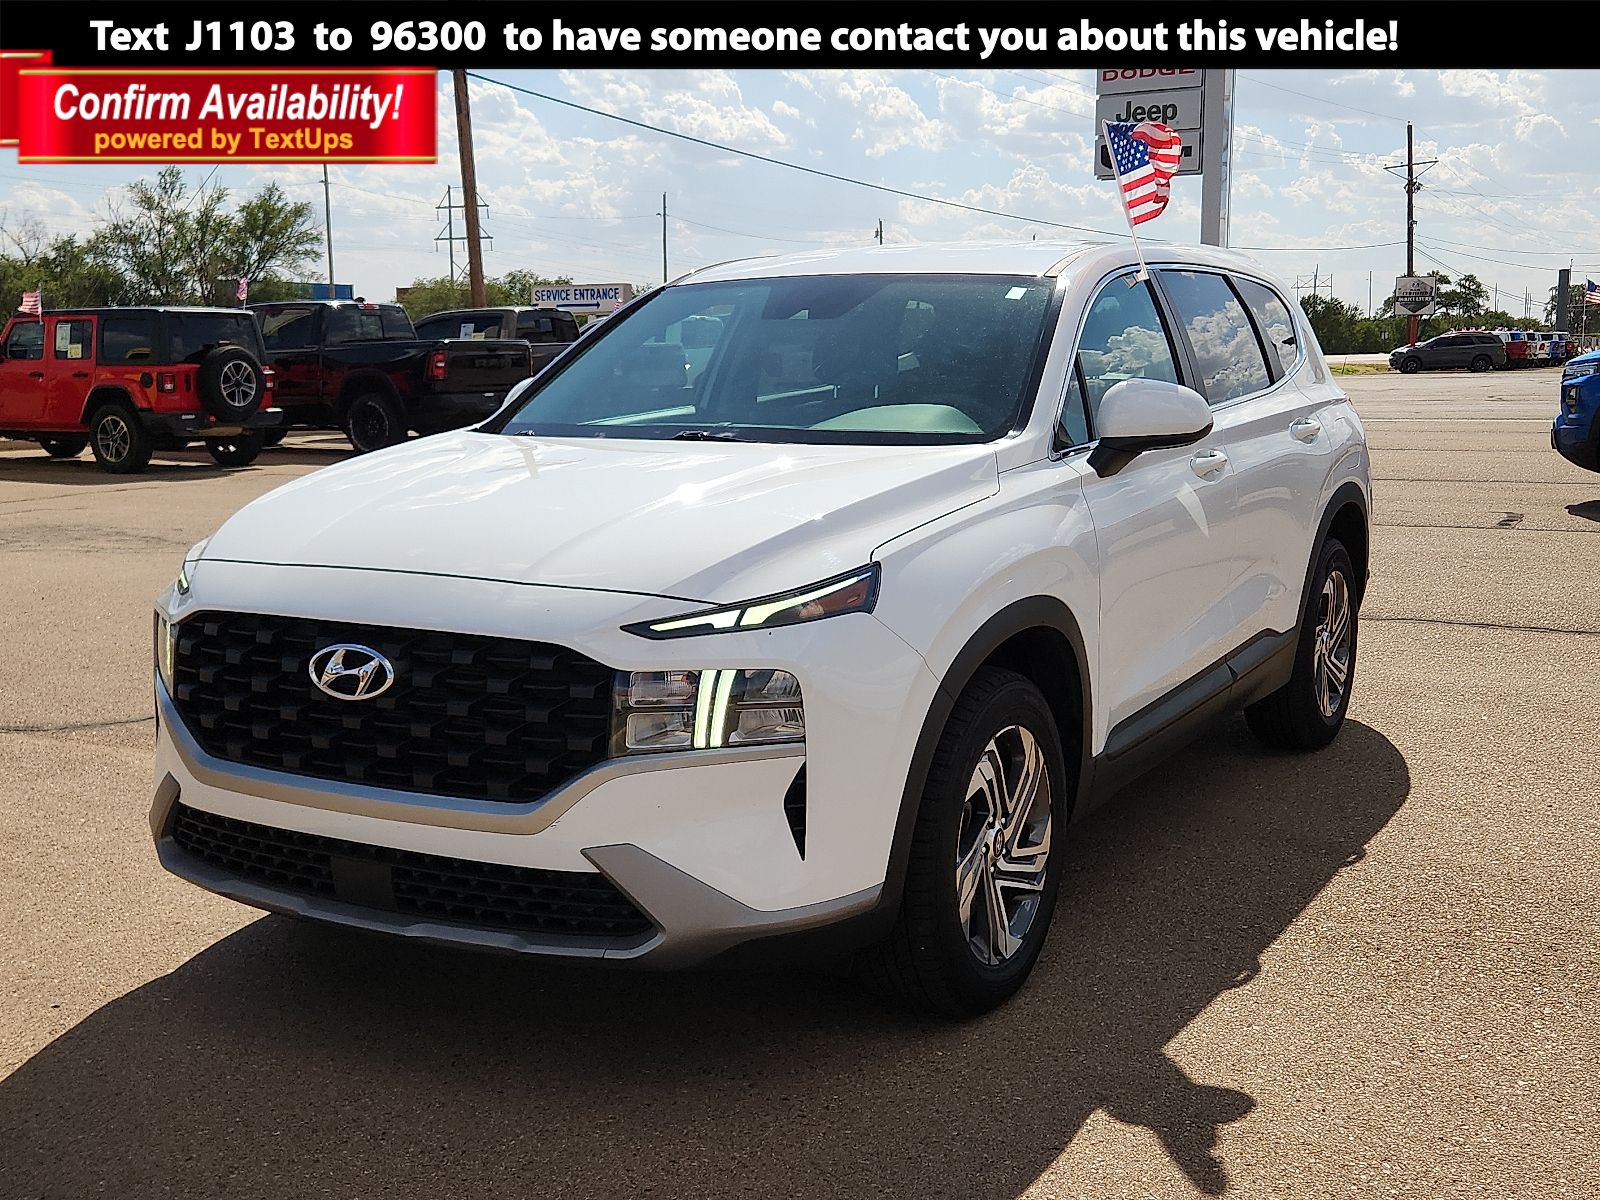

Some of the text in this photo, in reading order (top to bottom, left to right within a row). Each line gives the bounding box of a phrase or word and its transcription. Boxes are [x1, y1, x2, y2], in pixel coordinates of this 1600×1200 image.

[1116, 101, 1178, 124] Jeep
[534, 287, 620, 302] SERVICE ENTRANCE
